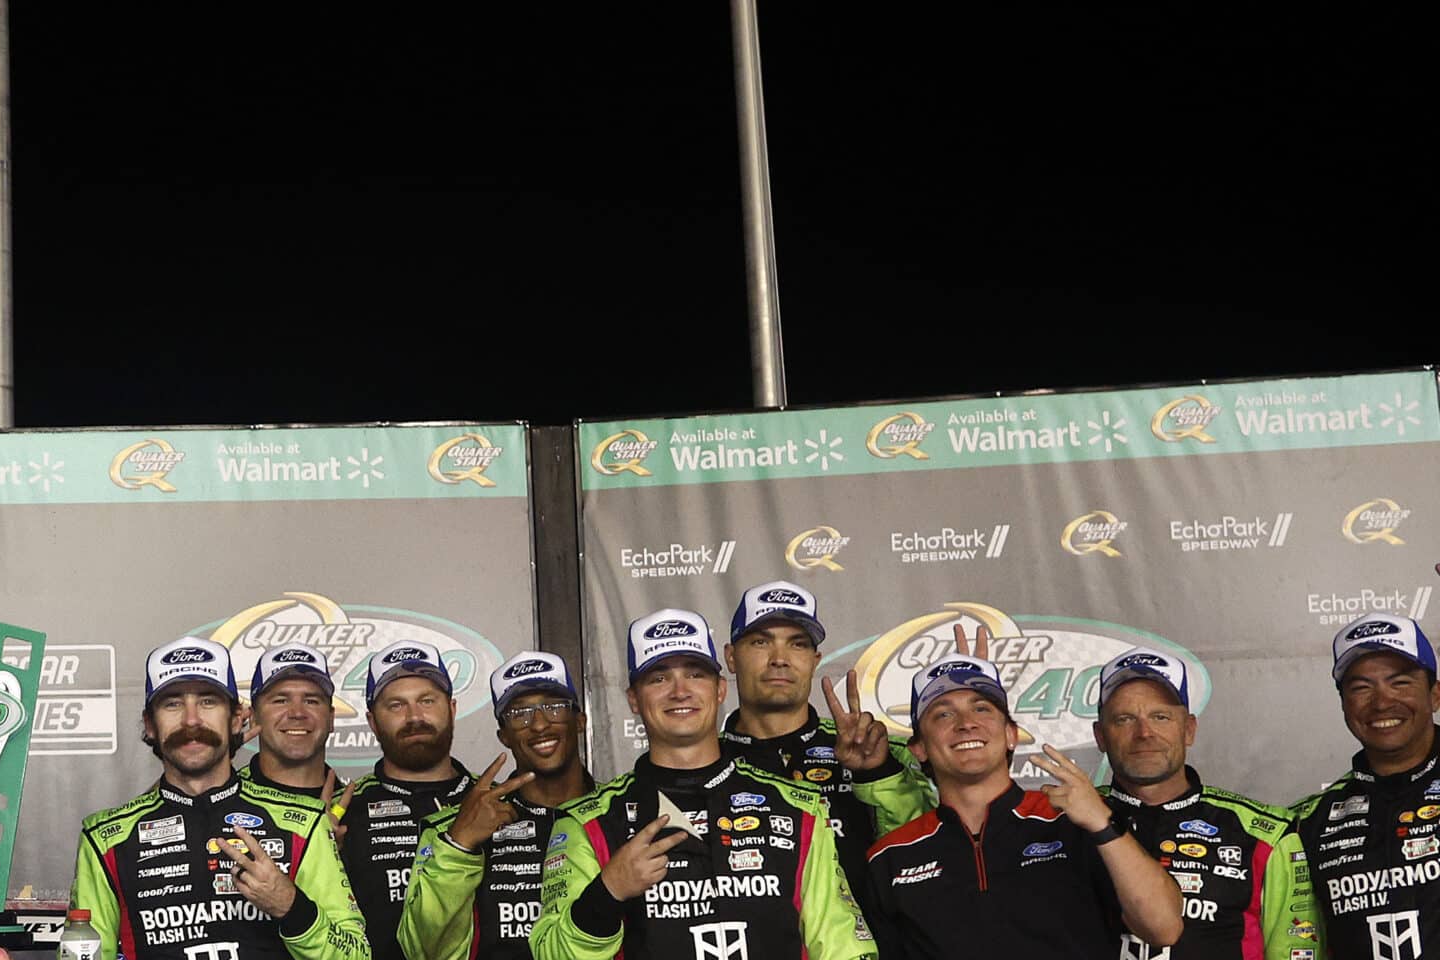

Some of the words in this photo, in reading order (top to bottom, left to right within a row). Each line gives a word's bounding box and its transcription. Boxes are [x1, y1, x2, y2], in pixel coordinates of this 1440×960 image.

[1235, 392, 1306, 408] Available
[1311, 391, 1327, 403] at
[948, 409, 1018, 425] Available
[1022, 410, 1037, 422] at
[1169, 405, 1222, 418] QUAKER
[1236, 406, 1372, 436] Walmart
[670, 429, 739, 444] Available
[741, 429, 756, 440] at
[885, 423, 936, 435] QUAKER
[890, 431, 926, 442] STATE
[948, 421, 1081, 455] Walmart
[217, 442, 280, 455] Available
[284, 442, 300, 454] at
[447, 446, 502, 458] QUAKER
[609, 440, 657, 453] QUAKER
[129, 451, 186, 464] QUAKER
[453, 456, 493, 467] STATE
[613, 450, 648, 460] STATE
[670, 440, 798, 471] Walmart
[134, 461, 178, 472] STATE
[217, 457, 341, 484] Walmart
[1170, 516, 1268, 539] EchoPark
[891, 528, 985, 552] EchoPark
[1182, 539, 1259, 551] SPEEDWAY
[621, 543, 712, 568] EchoPark
[902, 550, 977, 563] SPEEDWAY
[631, 566, 704, 577] SPEEDWAY
[1307, 590, 1408, 614] EchoPark
[655, 622, 688, 637] Ford
[644, 640, 703, 656] RACING
[170, 648, 204, 664] Ford
[159, 666, 218, 680] RACING
[283, 811, 308, 822] OMP
[100, 824, 122, 838] OMP
[770, 817, 793, 834] PPG
[1251, 818, 1276, 832] OMP
[139, 844, 187, 858] MENARDS
[150, 864, 189, 877] ADVANCE
[900, 861, 938, 876] TEAM
[892, 869, 943, 886] PENSKE
[137, 884, 192, 898] GOODYEAR
[645, 874, 781, 902] BODYARMOR
[646, 901, 691, 918] FLASH
[694, 901, 714, 917] I.V.
[1332, 895, 1369, 916] FLASH
[146, 929, 185, 945] FLASH
